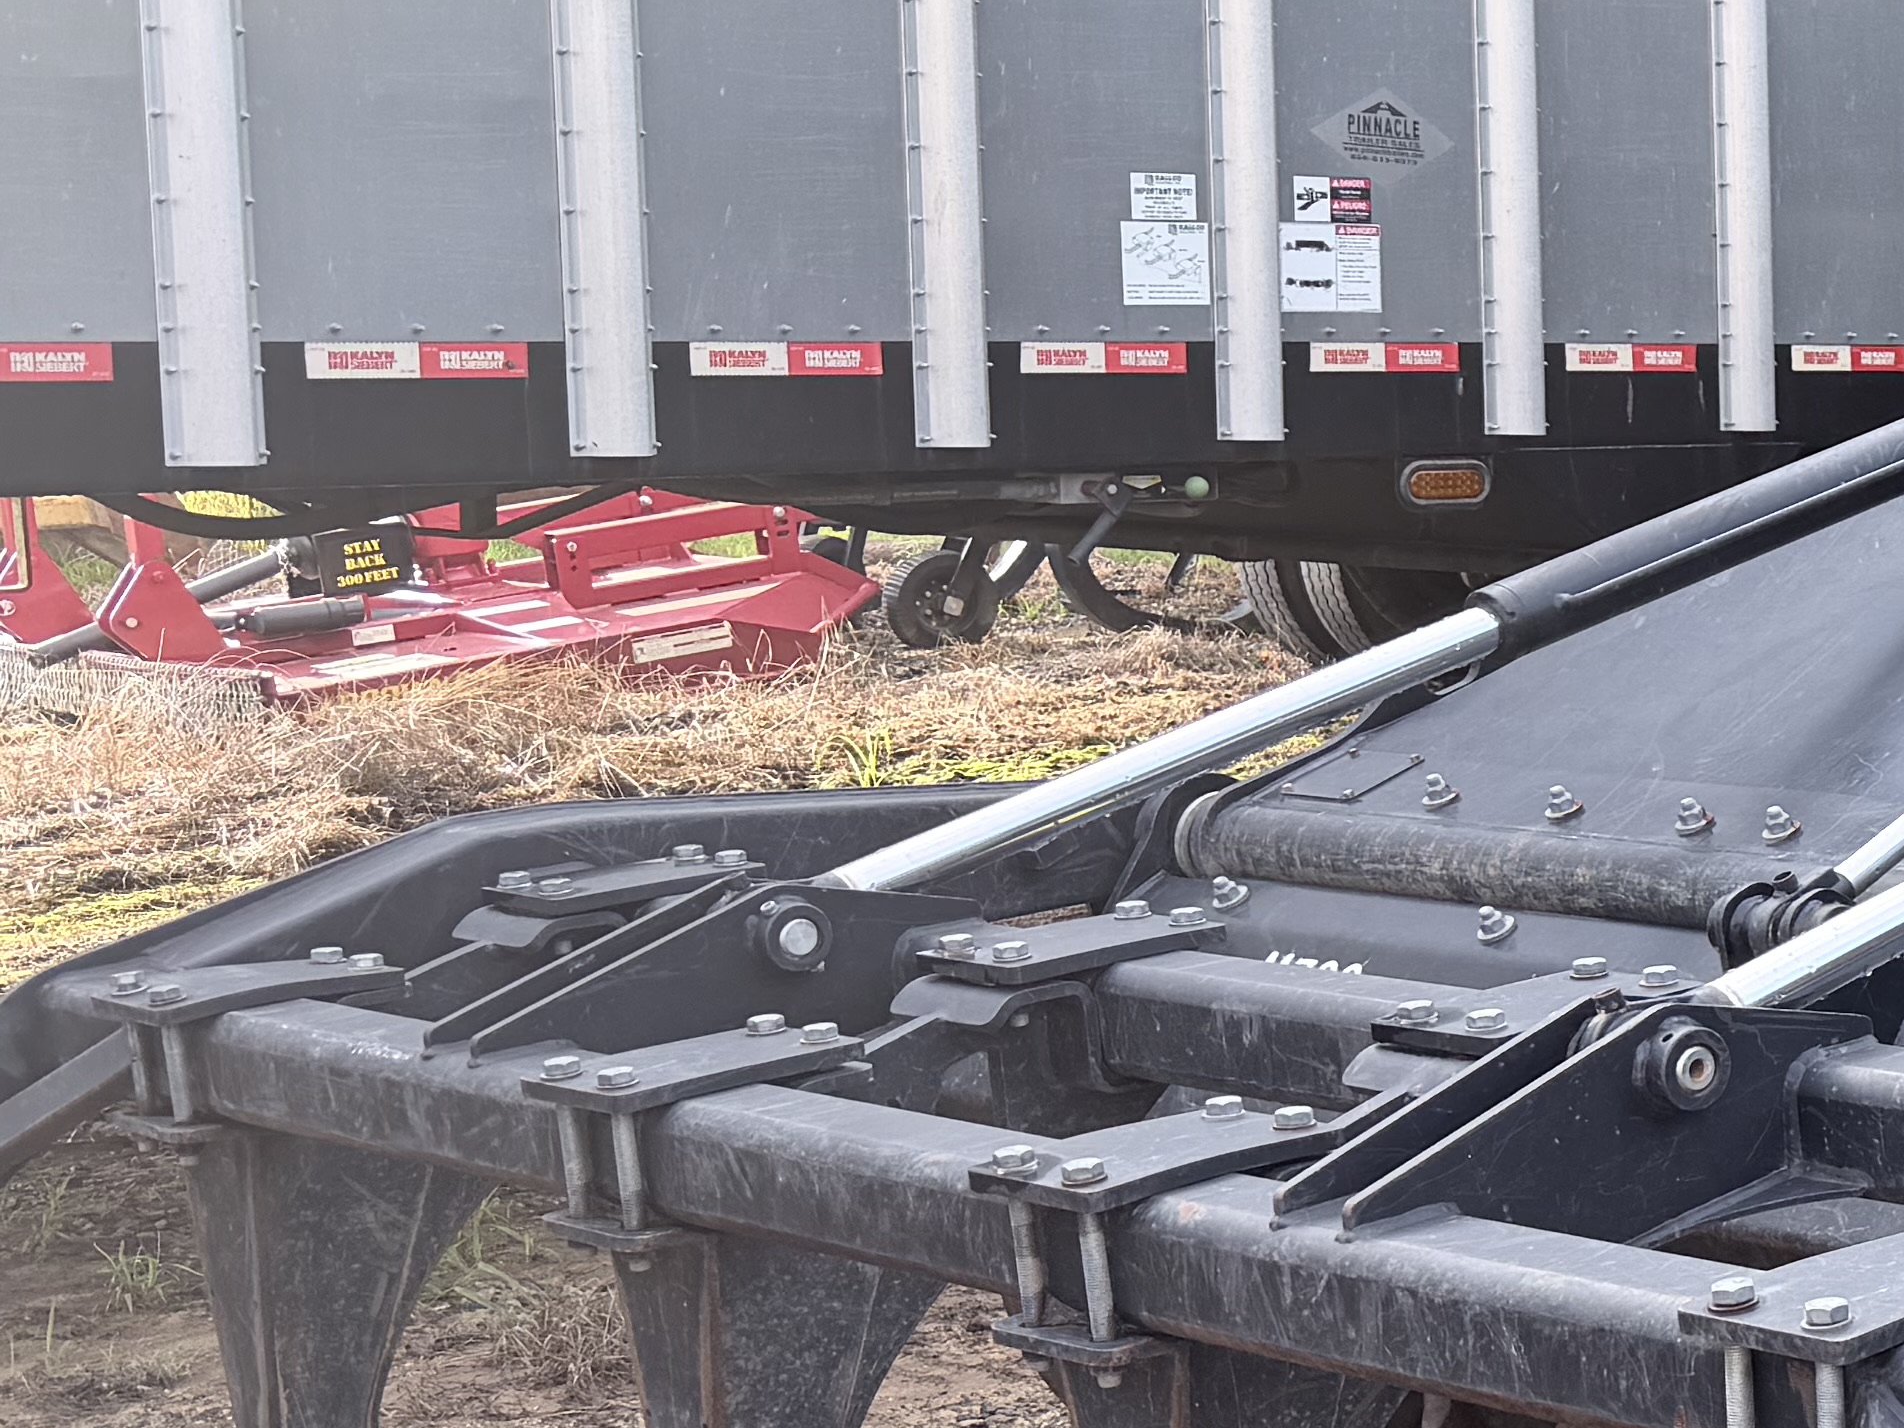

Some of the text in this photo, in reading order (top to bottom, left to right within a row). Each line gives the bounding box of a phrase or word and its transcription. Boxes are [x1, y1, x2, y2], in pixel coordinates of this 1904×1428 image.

[1347, 113, 1420, 138] PINNACLE
[34, 352, 86, 362] KALYN
[350, 350, 395, 360] KALYN
[461, 350, 505, 360] KALYN
[729, 350, 767, 359] KALYN
[824, 349, 861, 359] KALYN
[1053, 349, 1087, 357] KALYN
[1136, 349, 1169, 357] KALYN
[344, 539, 380, 555] STAY
[344, 553, 386, 570] BACK
[337, 567, 399, 587] 300 FEET
